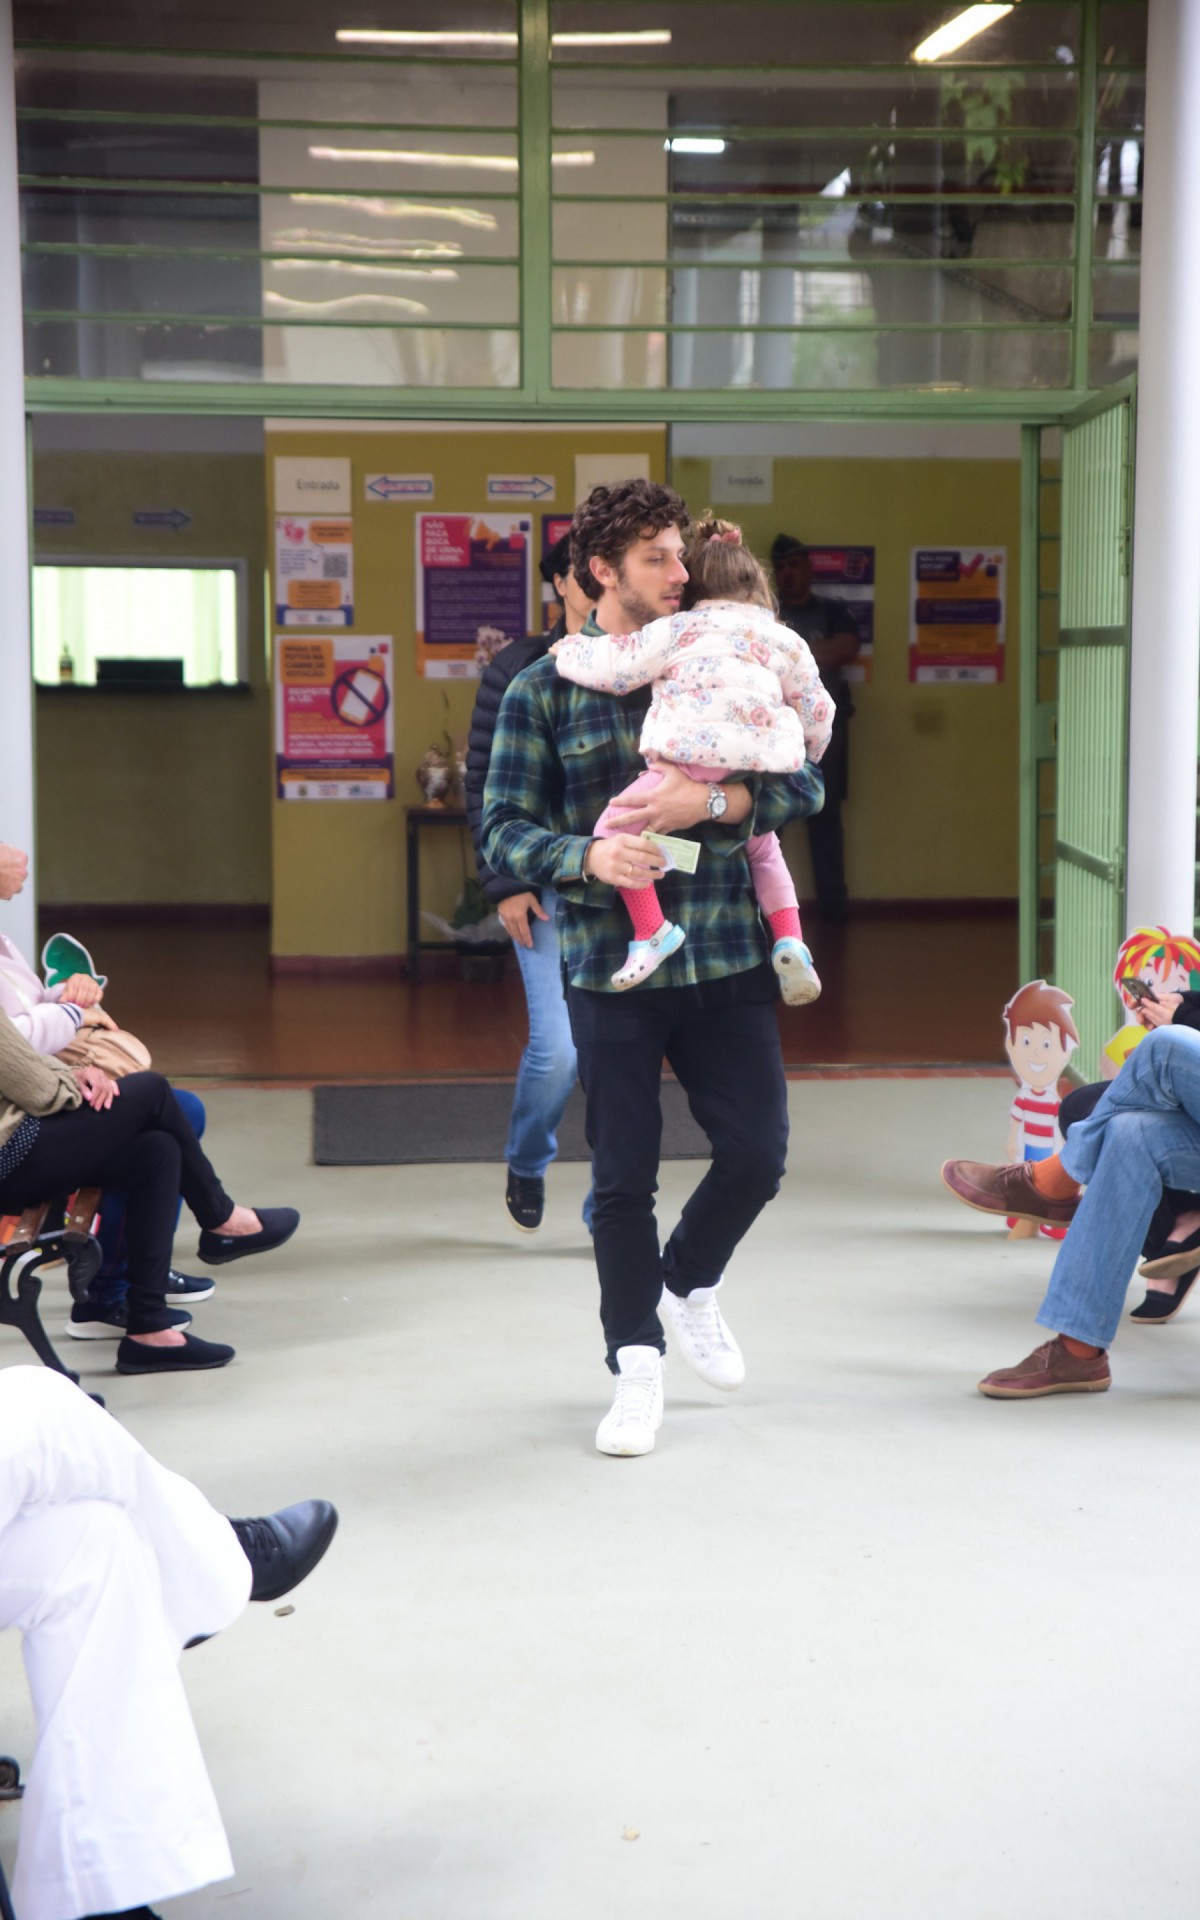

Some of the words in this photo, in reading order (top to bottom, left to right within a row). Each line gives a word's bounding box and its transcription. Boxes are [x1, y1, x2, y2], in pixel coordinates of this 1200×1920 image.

[296, 478, 340, 490] Entrada
[425, 518, 445, 529] NÃO
[425, 537, 450, 546] BOCA
